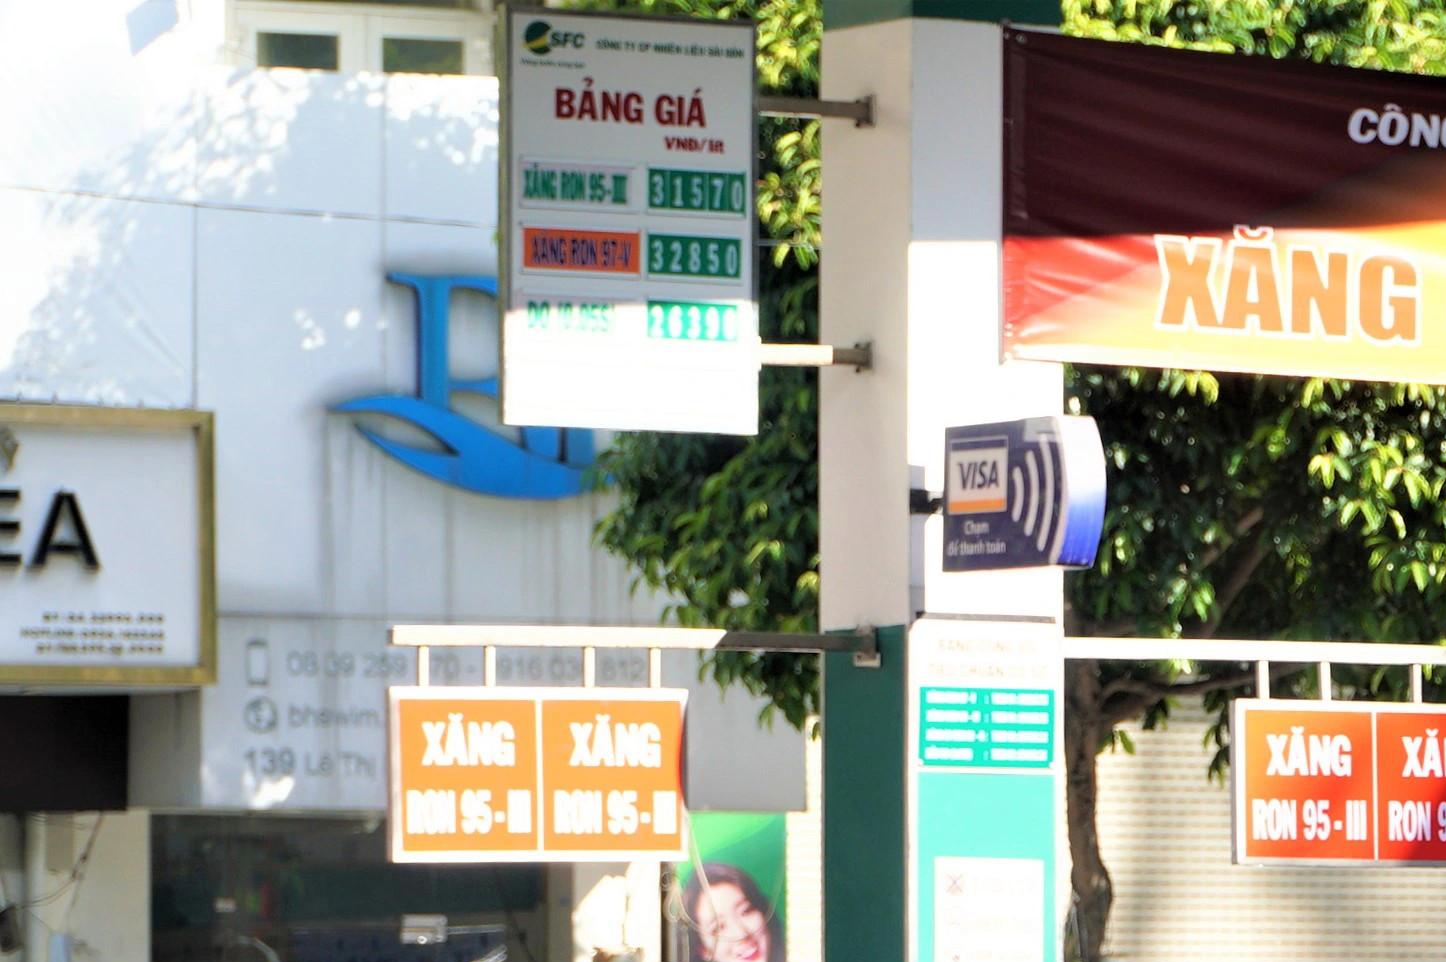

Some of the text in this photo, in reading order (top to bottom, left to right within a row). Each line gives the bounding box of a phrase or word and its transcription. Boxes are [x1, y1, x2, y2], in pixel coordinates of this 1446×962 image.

[550, 32, 585, 49] SFC
[555, 76, 706, 128] BẢNG GIÁ
[524, 162, 557, 199] XĂNG
[560, 169, 585, 201] RON
[651, 172, 744, 212] 31570
[571, 238, 598, 267] RON
[651, 239, 739, 275] 32850
[1155, 224, 1421, 347] XĂNG
[957, 460, 999, 490] VISA
[421, 712, 516, 767] XĂNG
[569, 714, 662, 768] XĂNG
[1266, 726, 1352, 777] XĂNG
[406, 789, 456, 834] RON
[554, 789, 602, 835] RON
[1252, 799, 1296, 840] RON
[1388, 800, 1431, 841] RON
